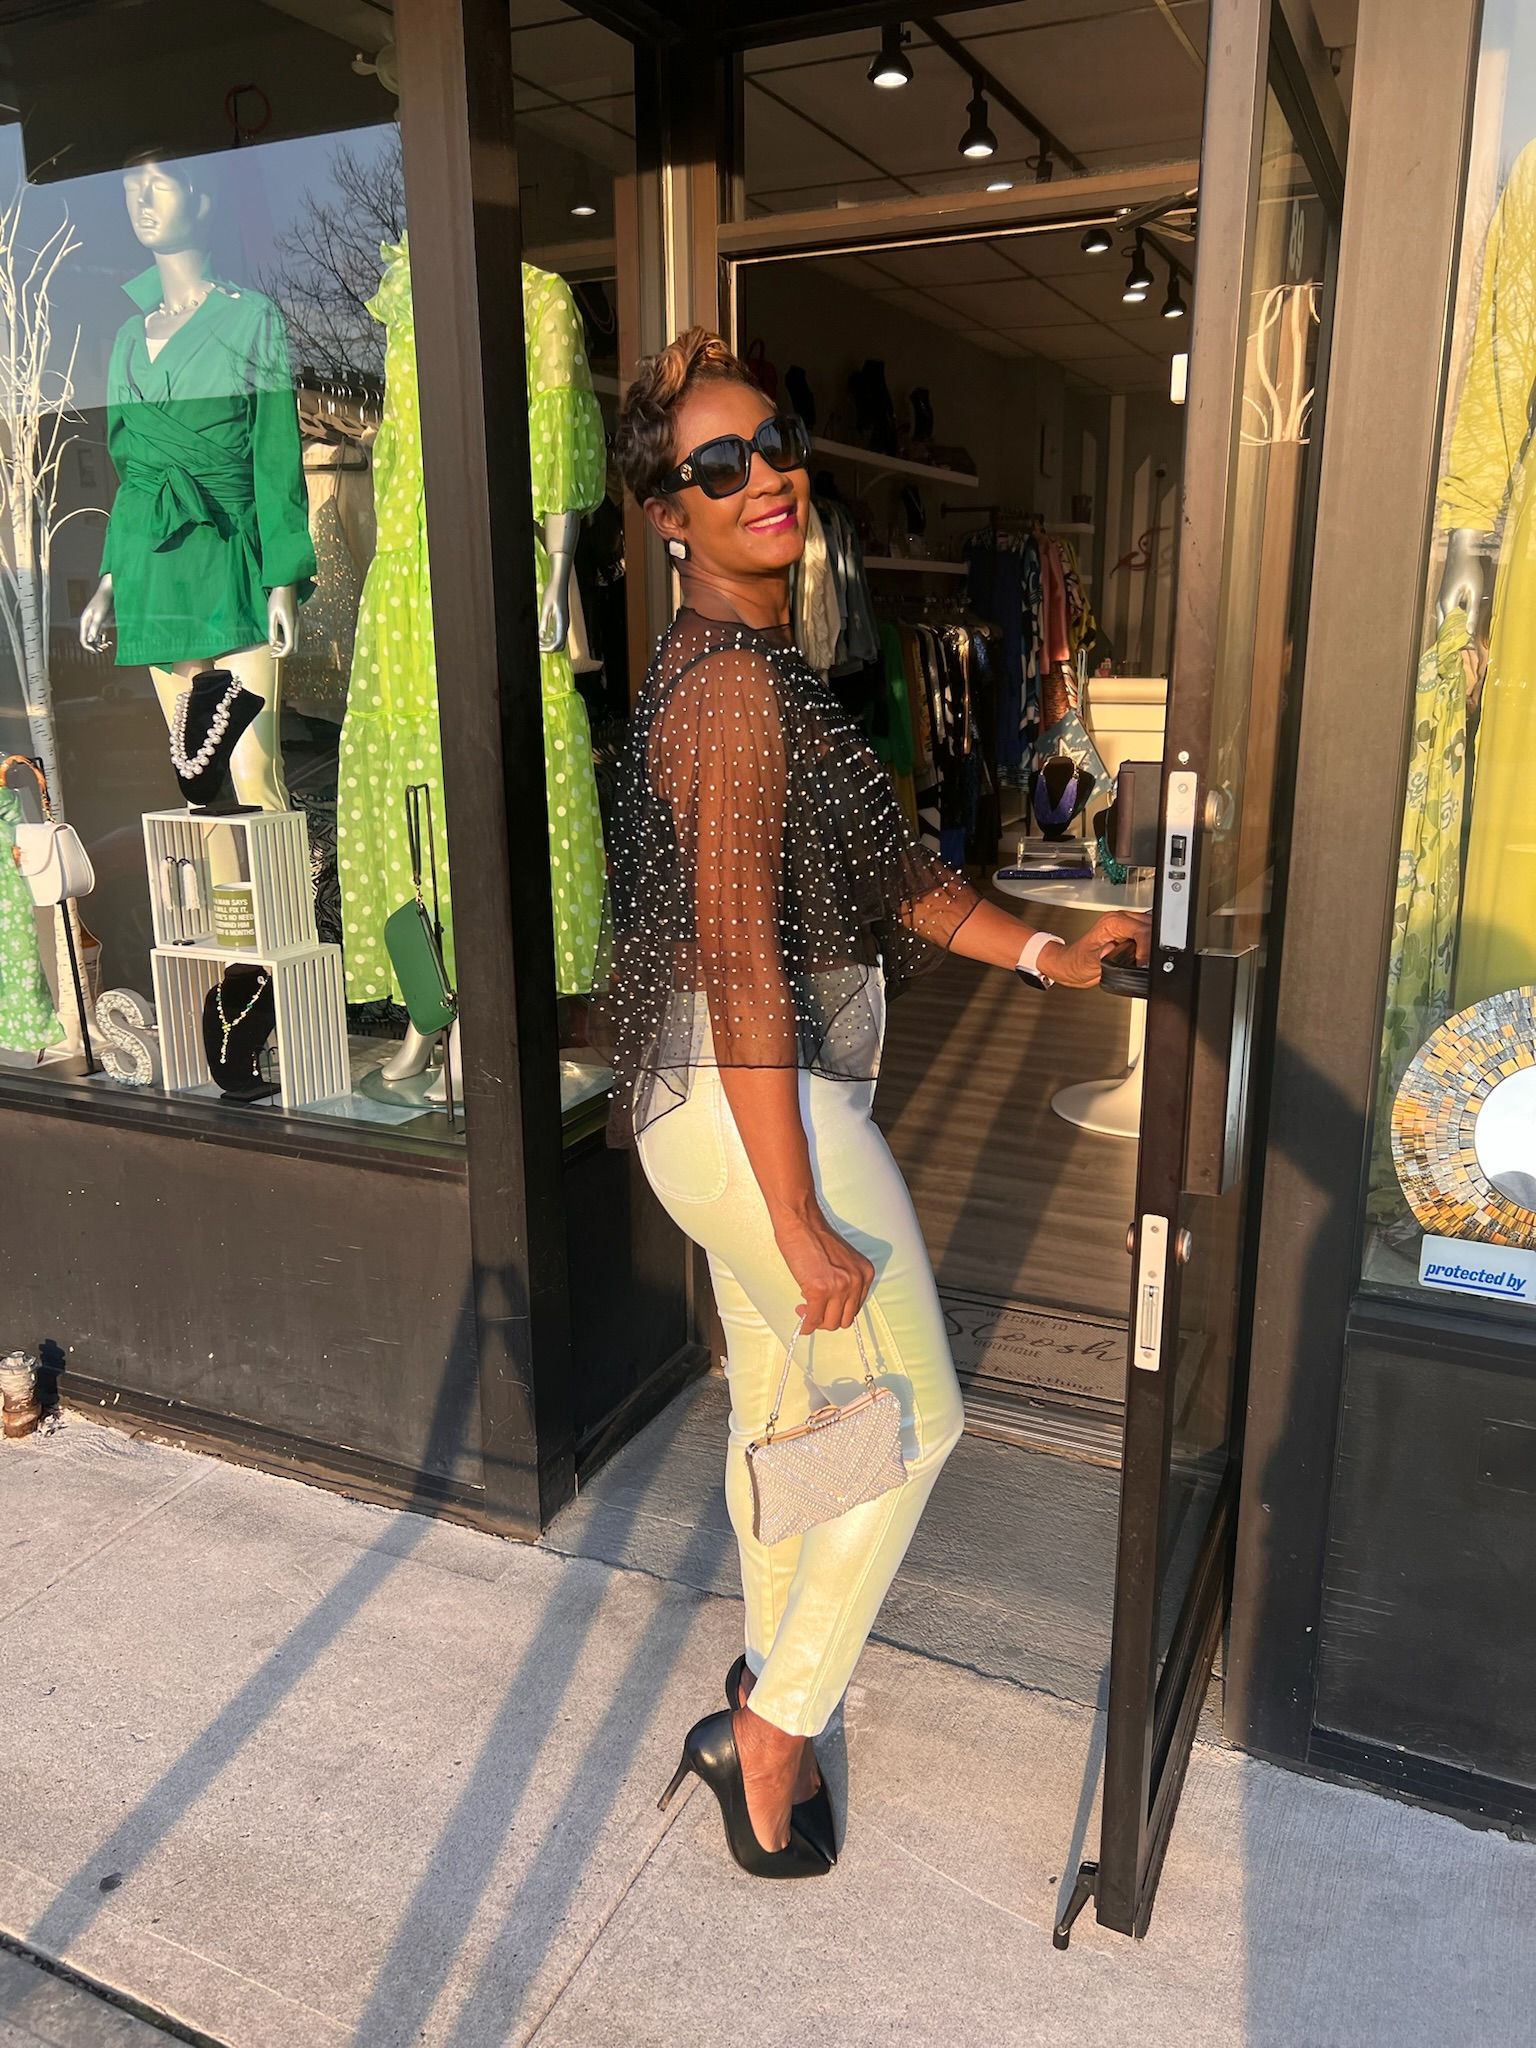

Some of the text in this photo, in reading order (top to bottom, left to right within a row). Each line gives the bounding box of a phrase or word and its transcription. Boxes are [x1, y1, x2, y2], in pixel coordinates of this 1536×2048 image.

[1289, 198, 1305, 280] 89
[95, 988, 161, 1086] S
[1425, 1263, 1527, 1291] protected by
[985, 1310, 1068, 1331] WELCOME TO
[974, 1339, 1042, 1359] BOUTIQUE
